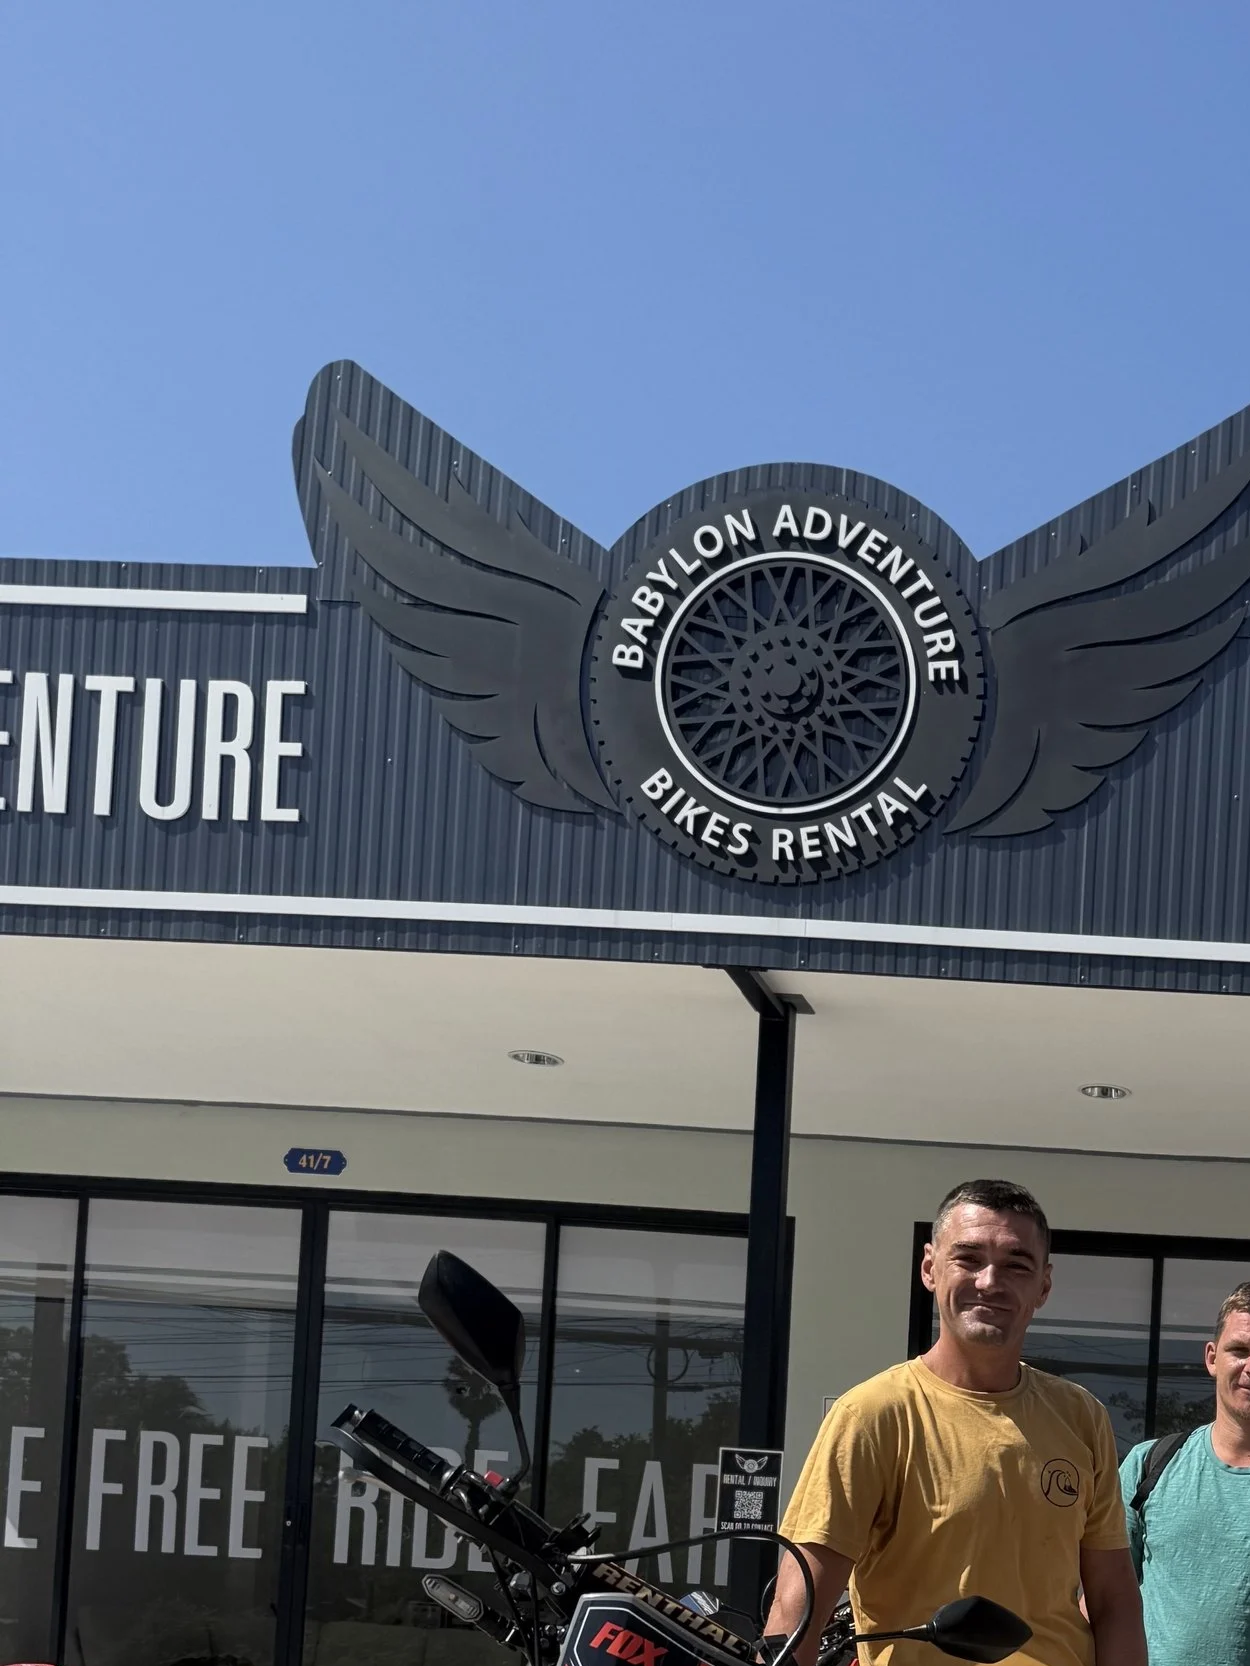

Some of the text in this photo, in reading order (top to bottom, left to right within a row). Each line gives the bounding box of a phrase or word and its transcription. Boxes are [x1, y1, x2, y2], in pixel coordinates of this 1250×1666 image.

[612, 504, 960, 682] BABYLON ADVENTURE
[0, 670, 308, 823] NTURE
[640, 768, 928, 861] BIKES RENTAL
[298, 1152, 332, 1171] 41/7
[86, 1428, 270, 1560] FREE
[592, 1562, 748, 1656] RENTHAL
